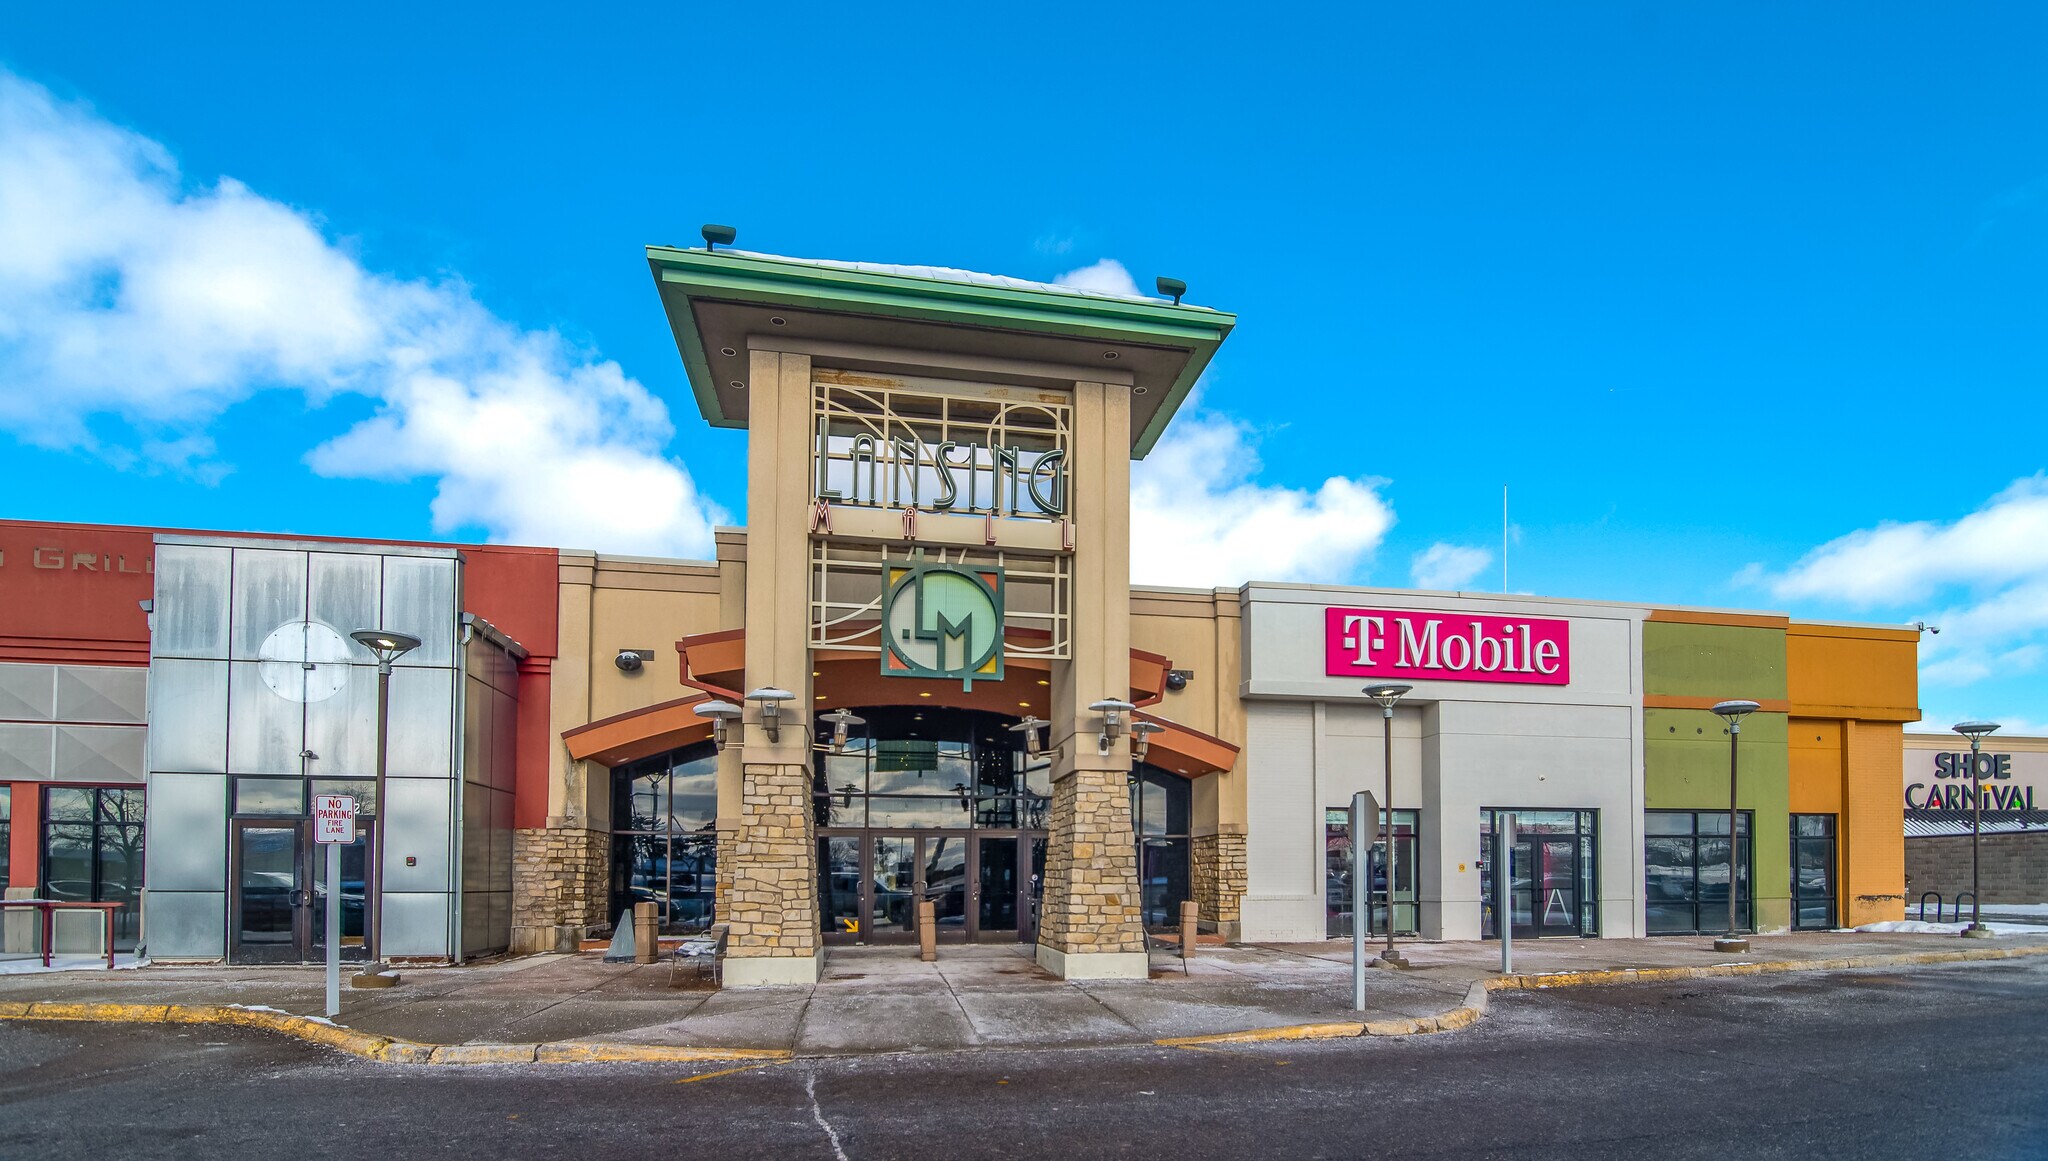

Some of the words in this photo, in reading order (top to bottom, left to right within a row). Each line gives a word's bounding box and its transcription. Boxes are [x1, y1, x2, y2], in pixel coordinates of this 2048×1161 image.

[817, 416, 1064, 517] LANSING
[810, 498, 1074, 550] MALL
[1394, 617, 1561, 675] Mobile
[1934, 752, 2011, 780] SHOE
[318, 810, 352, 820] PARKING
[328, 800, 342, 808] NO
